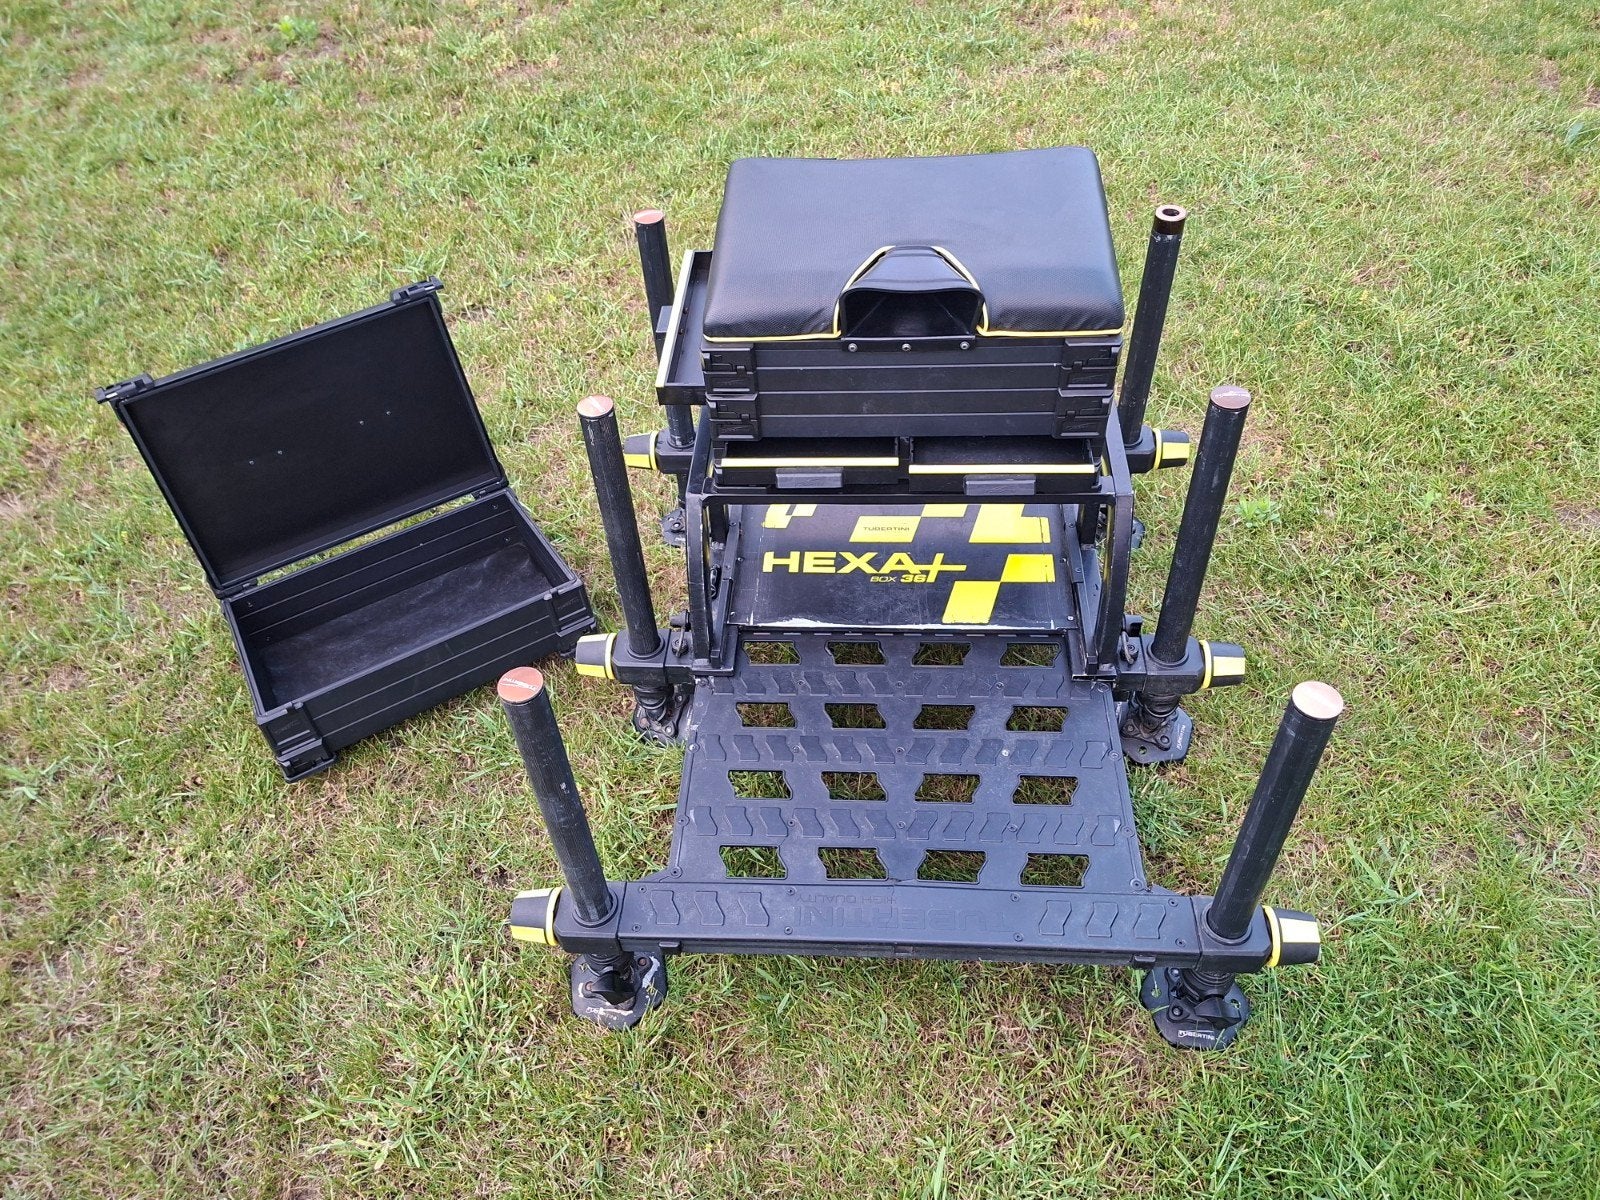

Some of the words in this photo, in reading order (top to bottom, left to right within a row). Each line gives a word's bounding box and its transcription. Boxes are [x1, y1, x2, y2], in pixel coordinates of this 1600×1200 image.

[900, 574, 927, 583] 36
[796, 894, 857, 904] QUALITY
[793, 906, 1015, 933] TUBERTINI
